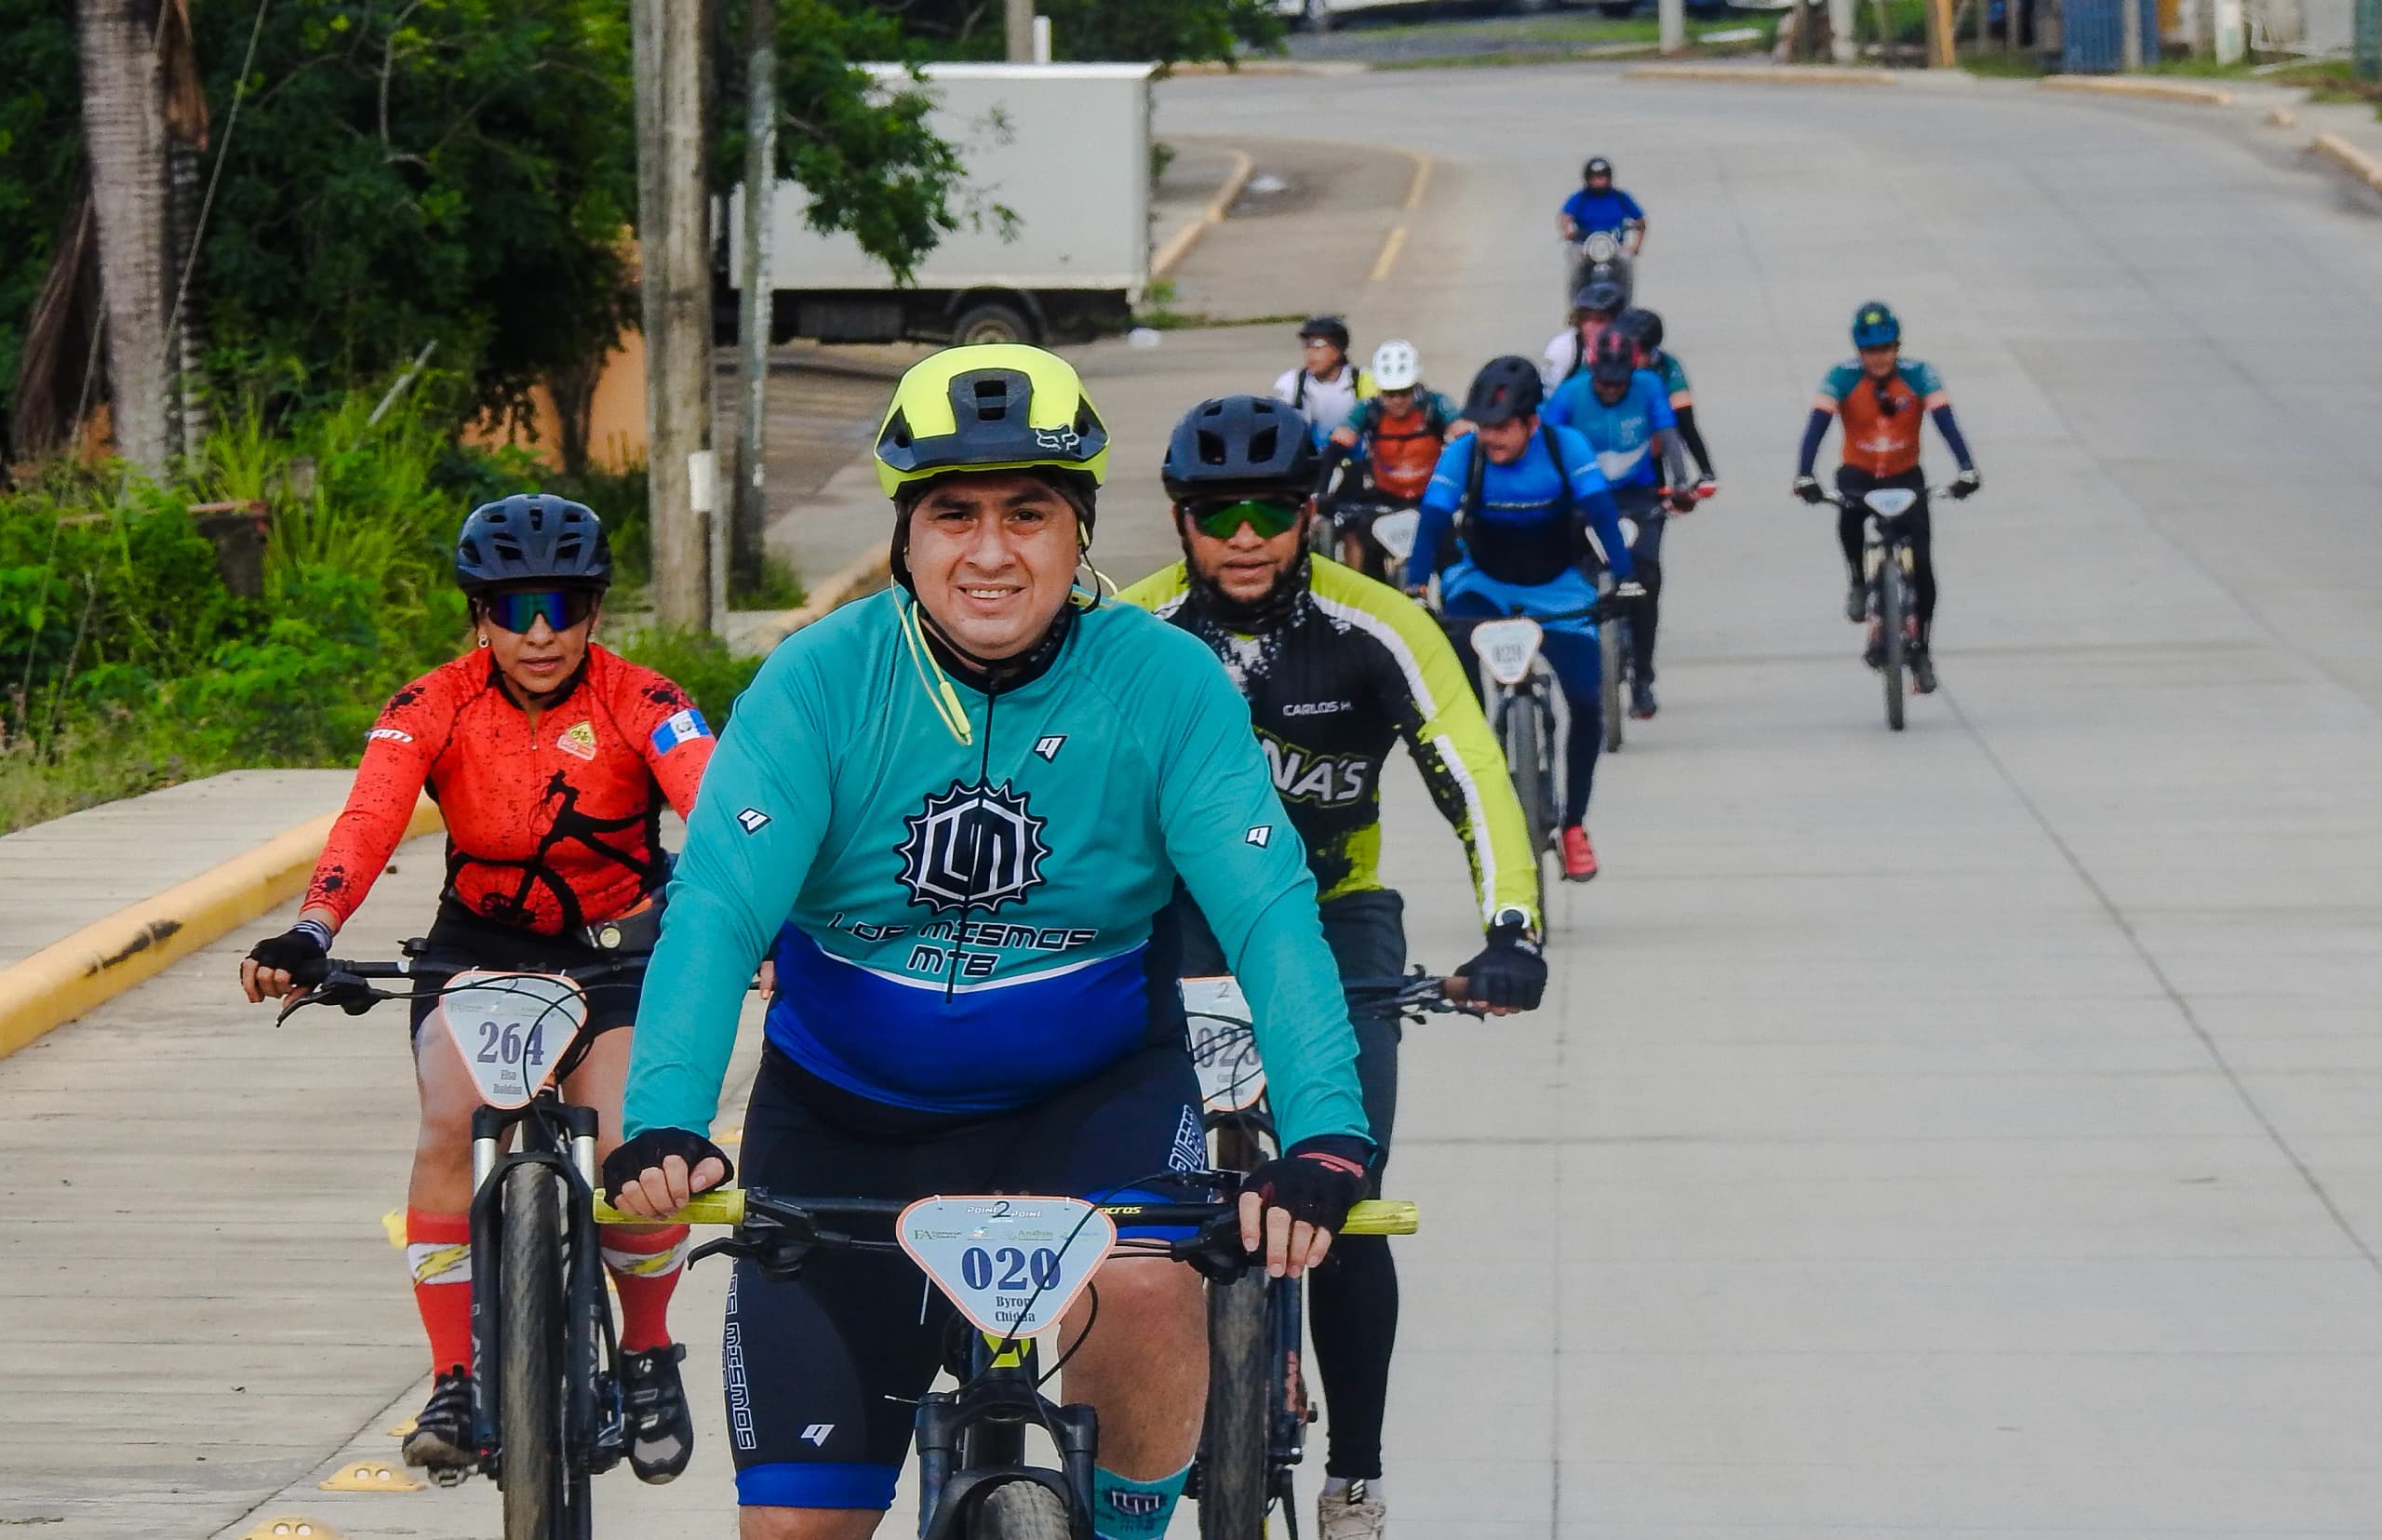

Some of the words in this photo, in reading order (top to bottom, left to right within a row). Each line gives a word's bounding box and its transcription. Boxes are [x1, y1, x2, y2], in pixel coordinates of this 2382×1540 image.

[1282, 701, 1339, 716] CARLOS
[918, 920, 1098, 952] MISMOS
[906, 944, 1000, 977] MTB
[476, 1021, 544, 1065] 264
[991, 1200, 1011, 1219] 2
[961, 1247, 1062, 1291] 020
[726, 1321, 757, 1450] MISMOS
